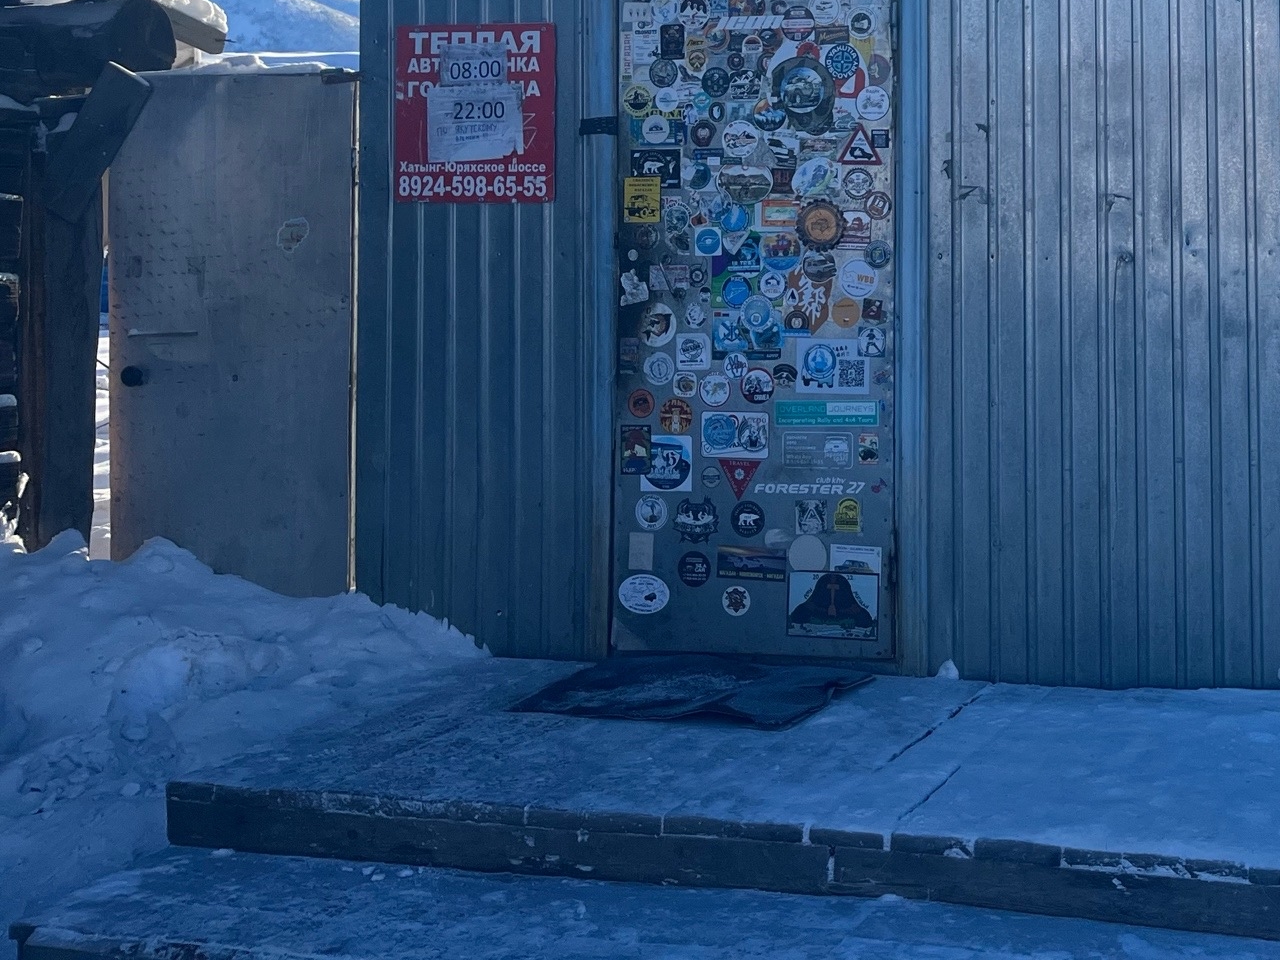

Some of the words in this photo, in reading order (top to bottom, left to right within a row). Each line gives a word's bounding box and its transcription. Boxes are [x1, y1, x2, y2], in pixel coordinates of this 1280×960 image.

[828, 45, 857, 59] YAKUTIA
[450, 60, 501, 80] 08:00
[826, 60, 859, 79] DISCOVERY
[453, 101, 505, 120] 22:00
[400, 161, 505, 175] Хатынг-Юряхское
[508, 161, 546, 173] шоссе
[399, 176, 547, 197] 8924-598-65-55
[781, 405, 825, 413] OVERLAND
[828, 405, 874, 413] JOURNEYS
[754, 483, 844, 494] FORESTER
[846, 482, 866, 494] 27
